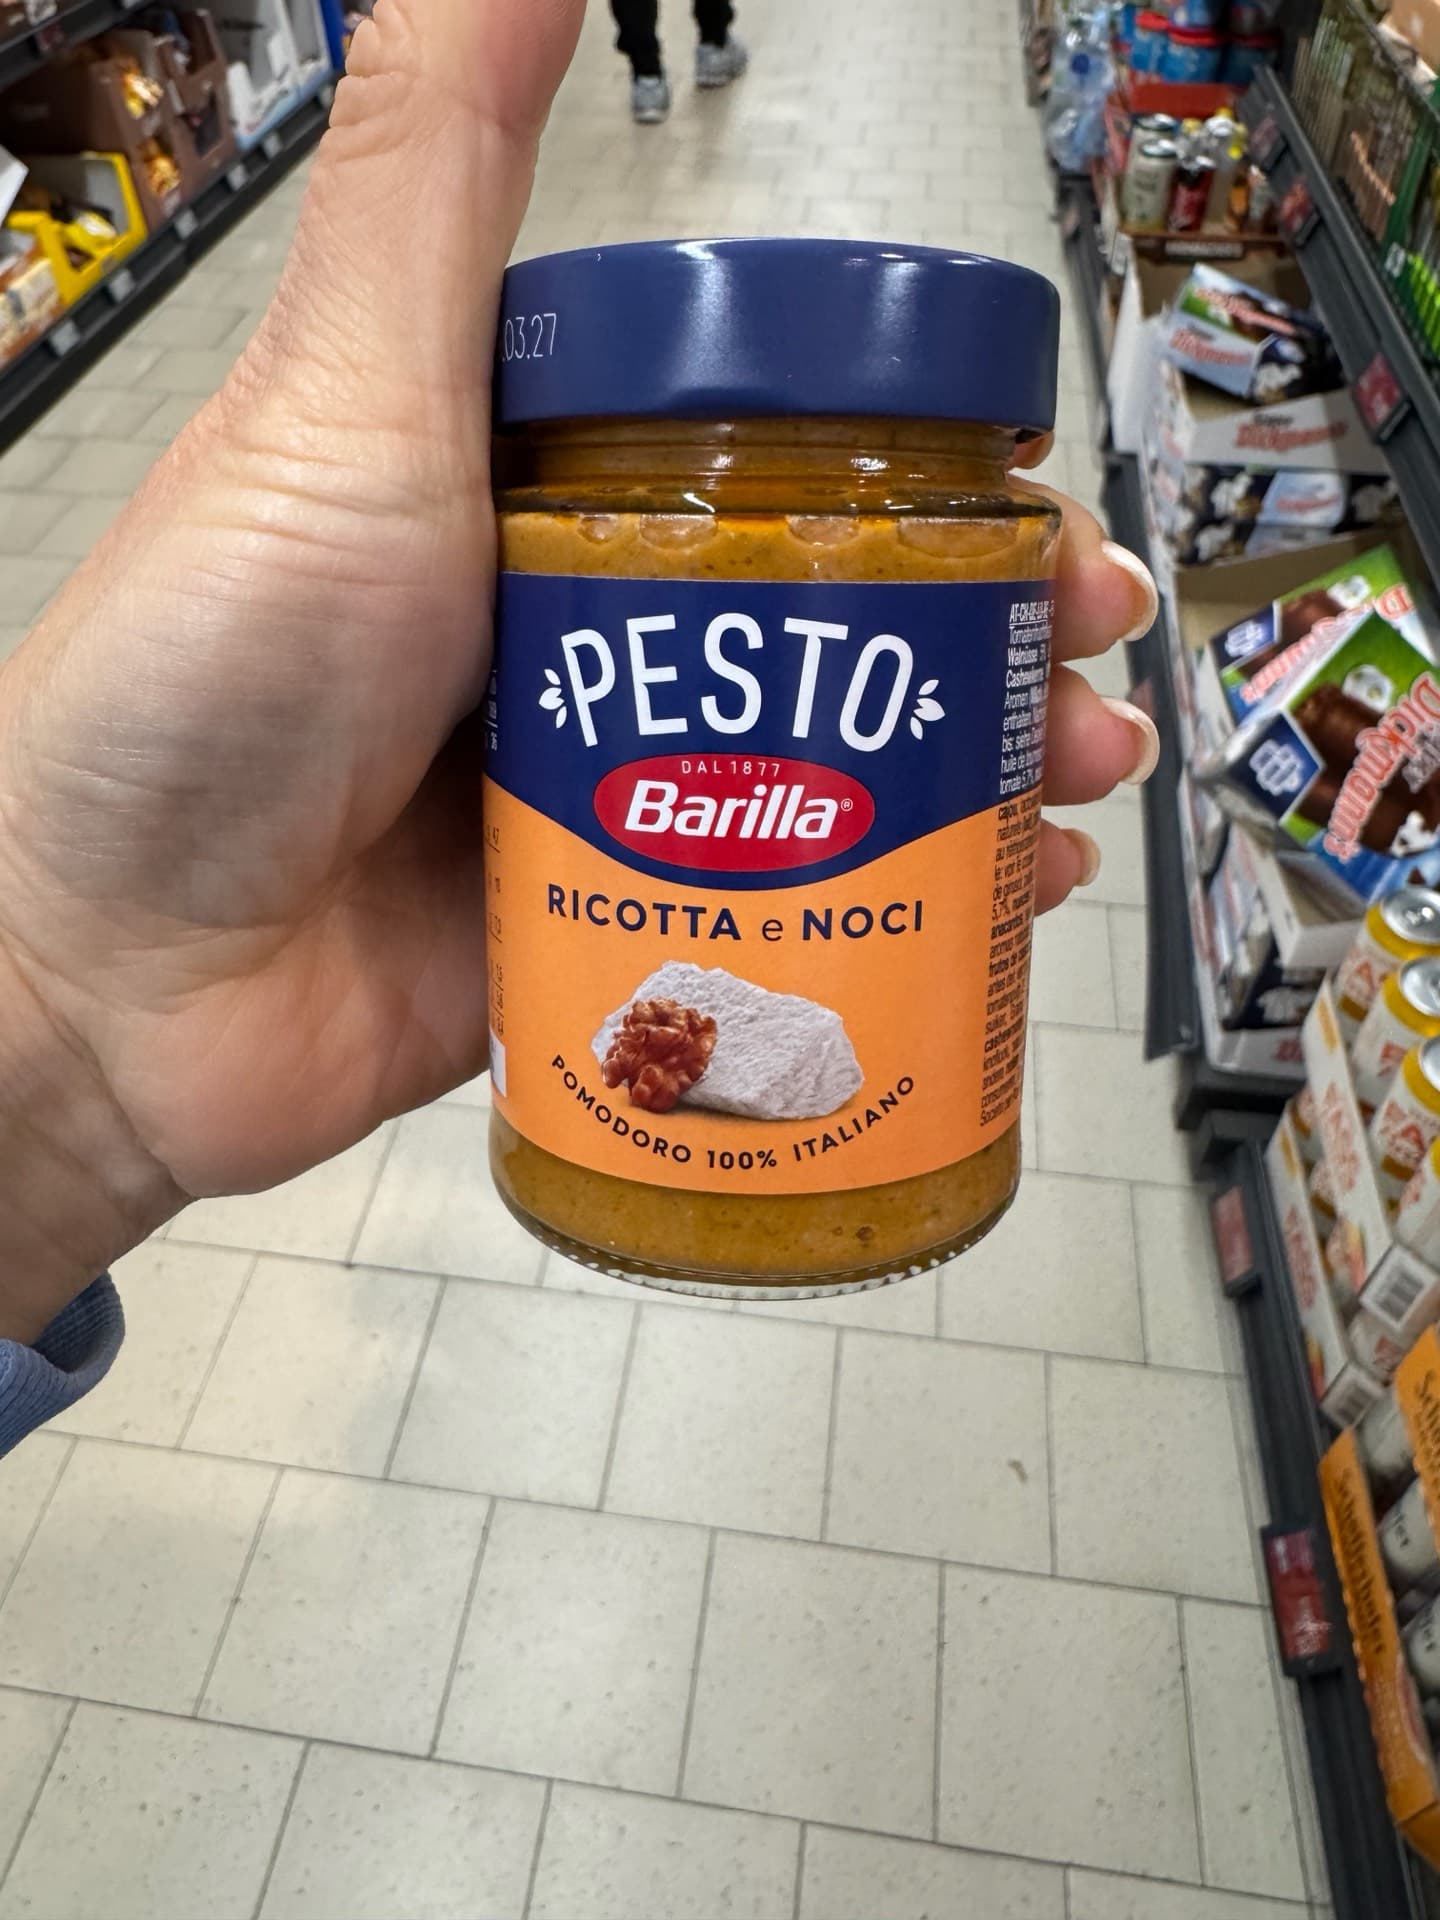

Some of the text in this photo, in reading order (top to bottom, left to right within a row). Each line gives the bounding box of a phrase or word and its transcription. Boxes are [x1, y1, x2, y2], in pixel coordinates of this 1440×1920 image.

[561, 612, 913, 752] PESTO
[681, 760, 781, 777] DAL 1877
[548, 883, 923, 941] RICOTTA e NOCI
[552, 1054, 691, 1163] POMODORO
[707, 1149, 777, 1170] 100%
[793, 1076, 914, 1162] ITALIANO
